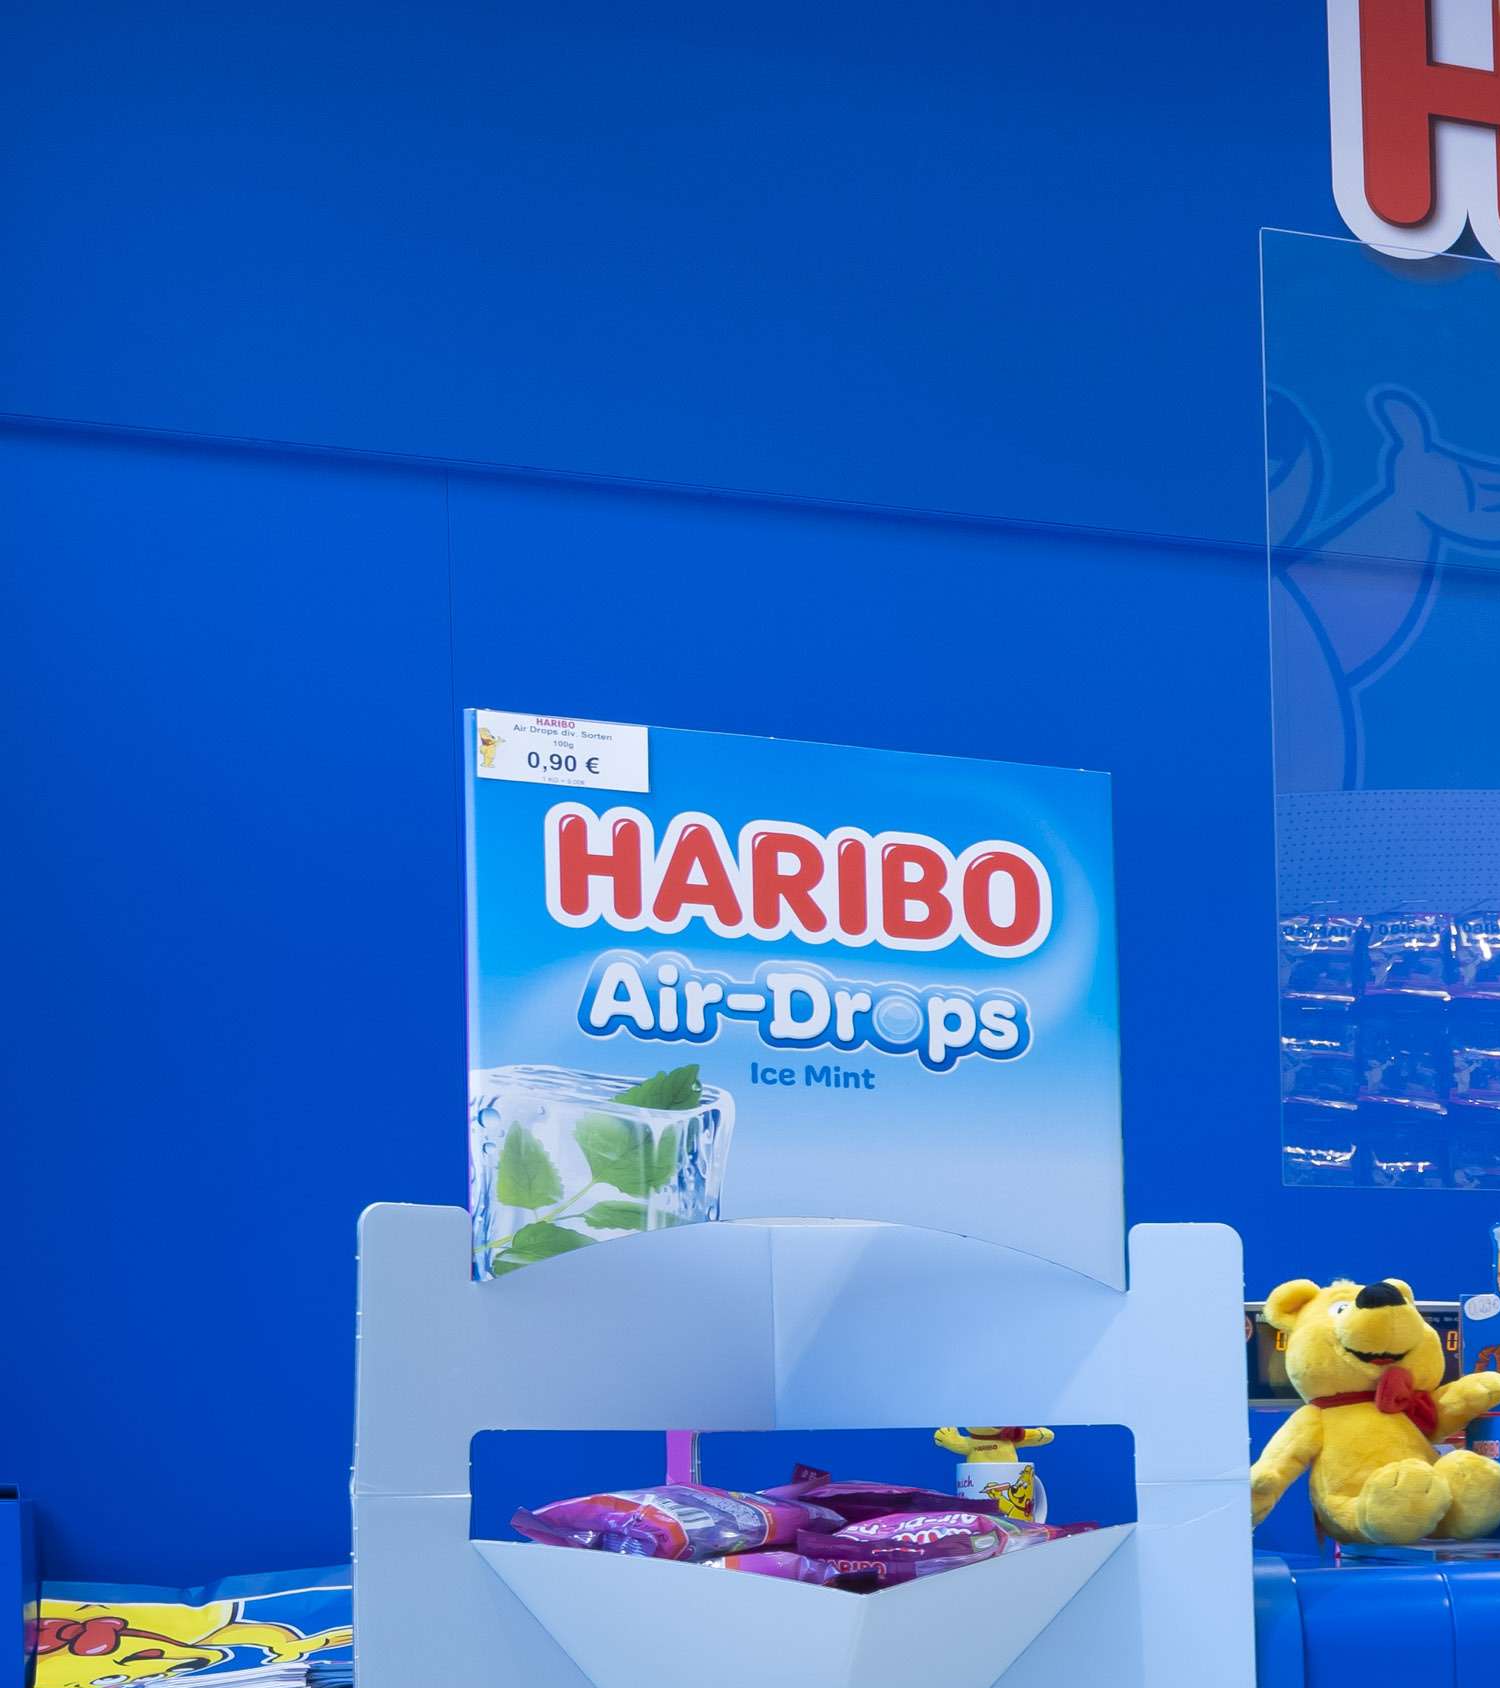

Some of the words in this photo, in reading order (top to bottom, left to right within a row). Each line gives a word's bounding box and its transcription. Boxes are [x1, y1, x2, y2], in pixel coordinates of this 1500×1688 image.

[514, 724, 527, 732] Air
[530, 725, 558, 736] Drops
[561, 728, 576, 738] div.
[582, 731, 612, 741] Sorten
[536, 718, 576, 729] HARIBO
[553, 740, 574, 750] 100g
[528, 751, 577, 772] 0,90
[585, 757, 600, 774] €
[552, 807, 1047, 953] HARIBO
[585, 960, 1023, 1066] Air-Drops
[749, 1061, 798, 1087] Ice
[803, 1062, 877, 1092] Mint
